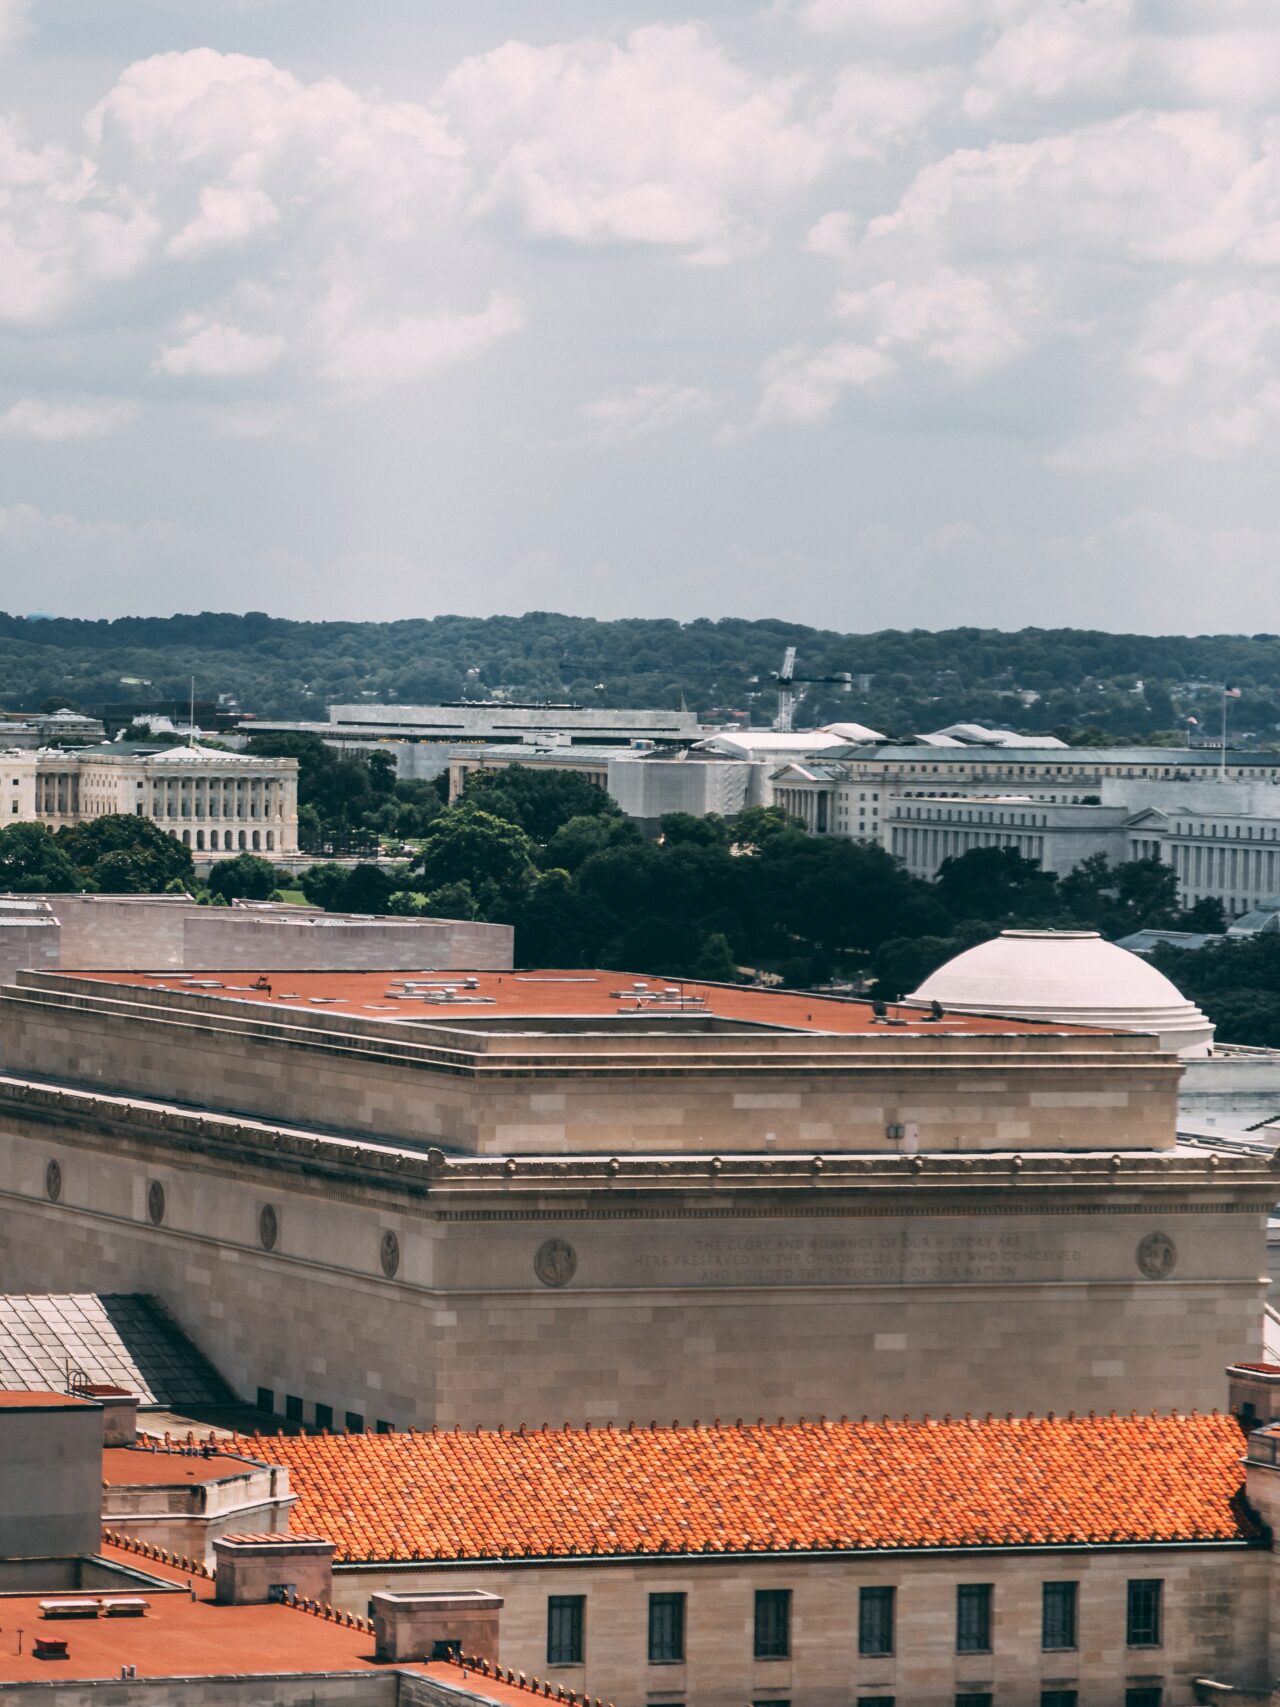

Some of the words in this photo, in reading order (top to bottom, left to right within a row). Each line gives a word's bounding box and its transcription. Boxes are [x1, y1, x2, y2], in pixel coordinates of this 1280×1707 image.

[696, 1240, 721, 1251] THE
[728, 1239, 770, 1251] GLORY
[777, 1239, 804, 1250] AND
[810, 1239, 877, 1249] ROMANCE
[880, 1238, 897, 1248] OF
[936, 1237, 991, 1248] HISTORY
[999, 1236, 1024, 1247] ARE
[634, 1256, 667, 1266] HERE
[675, 1255, 750, 1265] PRESERVED
[757, 1255, 769, 1264] IN
[777, 1254, 801, 1264] THE
[806, 1253, 892, 1264] CHRONICLES
[919, 1252, 960, 1263] THOSE
[1003, 1251, 1081, 1261] CONCEIVED
[703, 1270, 730, 1280] AND
[736, 1269, 793, 1280] BUILDED
[800, 1268, 825, 1279] THE
[831, 1267, 904, 1278] STRUCTURE
[911, 1267, 926, 1278] OF
[933, 1266, 960, 1278] OUR
[966, 1266, 1016, 1277] NATION
